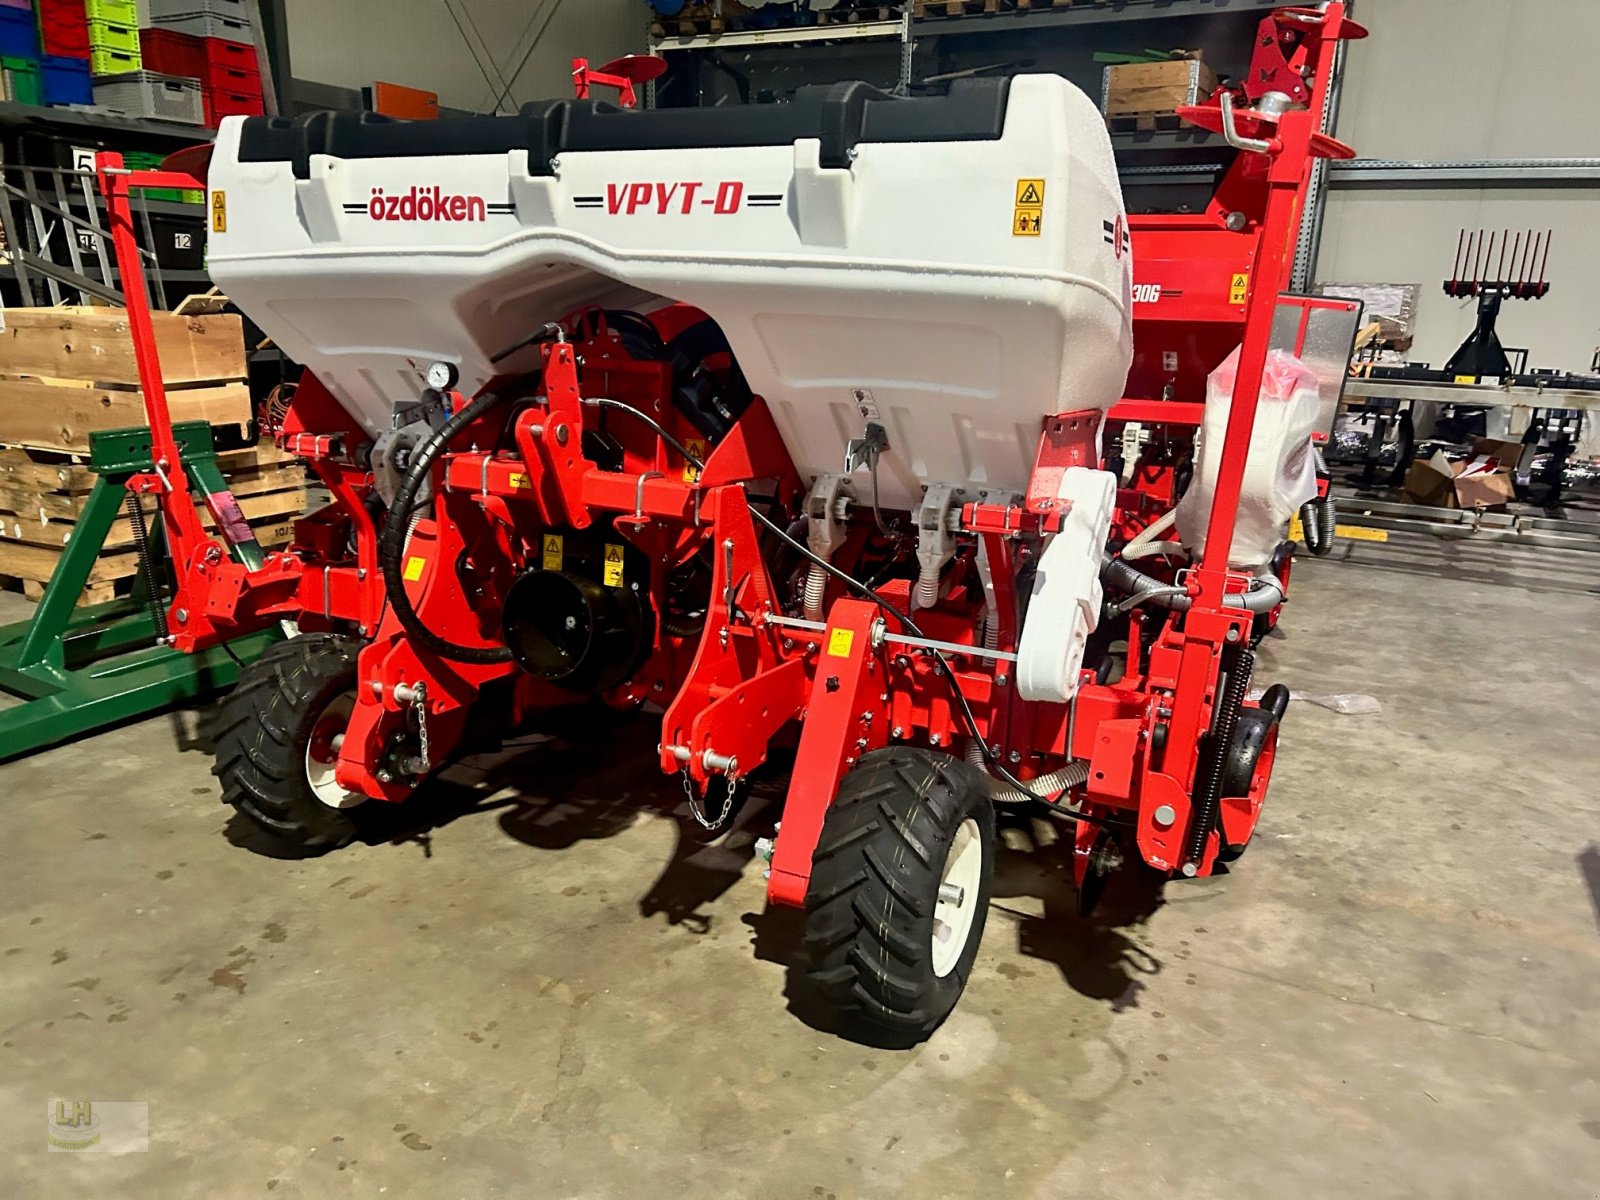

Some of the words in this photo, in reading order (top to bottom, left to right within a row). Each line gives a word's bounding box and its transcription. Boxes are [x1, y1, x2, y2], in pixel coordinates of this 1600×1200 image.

[369, 186, 486, 222] özdöken
[607, 182, 744, 215] VPYT-D
[175, 235, 191, 248] 12
[1132, 284, 1161, 303] 306
